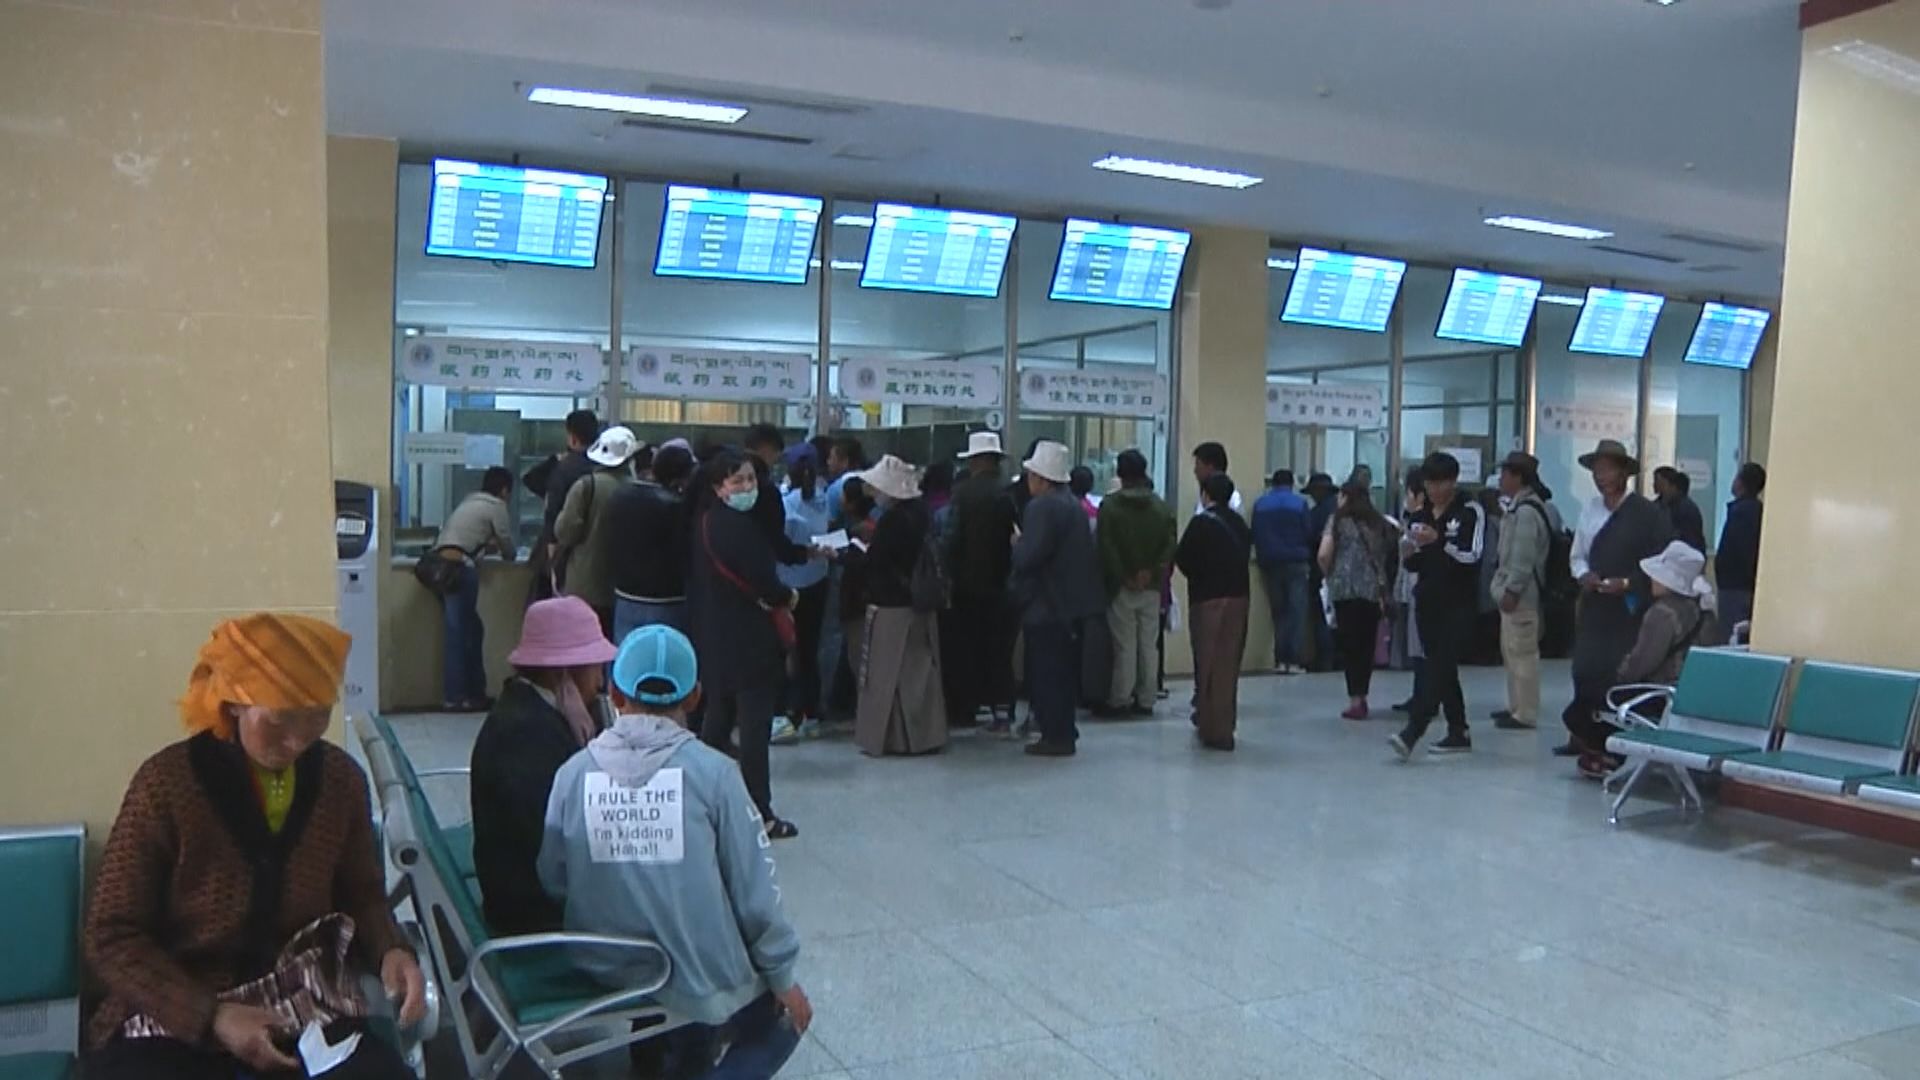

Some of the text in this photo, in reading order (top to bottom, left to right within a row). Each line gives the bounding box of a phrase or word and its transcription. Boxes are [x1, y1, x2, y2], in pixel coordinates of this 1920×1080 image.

[803, 404, 812, 419] 2
[588, 790, 676, 806] I RULE THE
[601, 808, 660, 821] WORLD
[594, 826, 673, 842] I'm kidding
